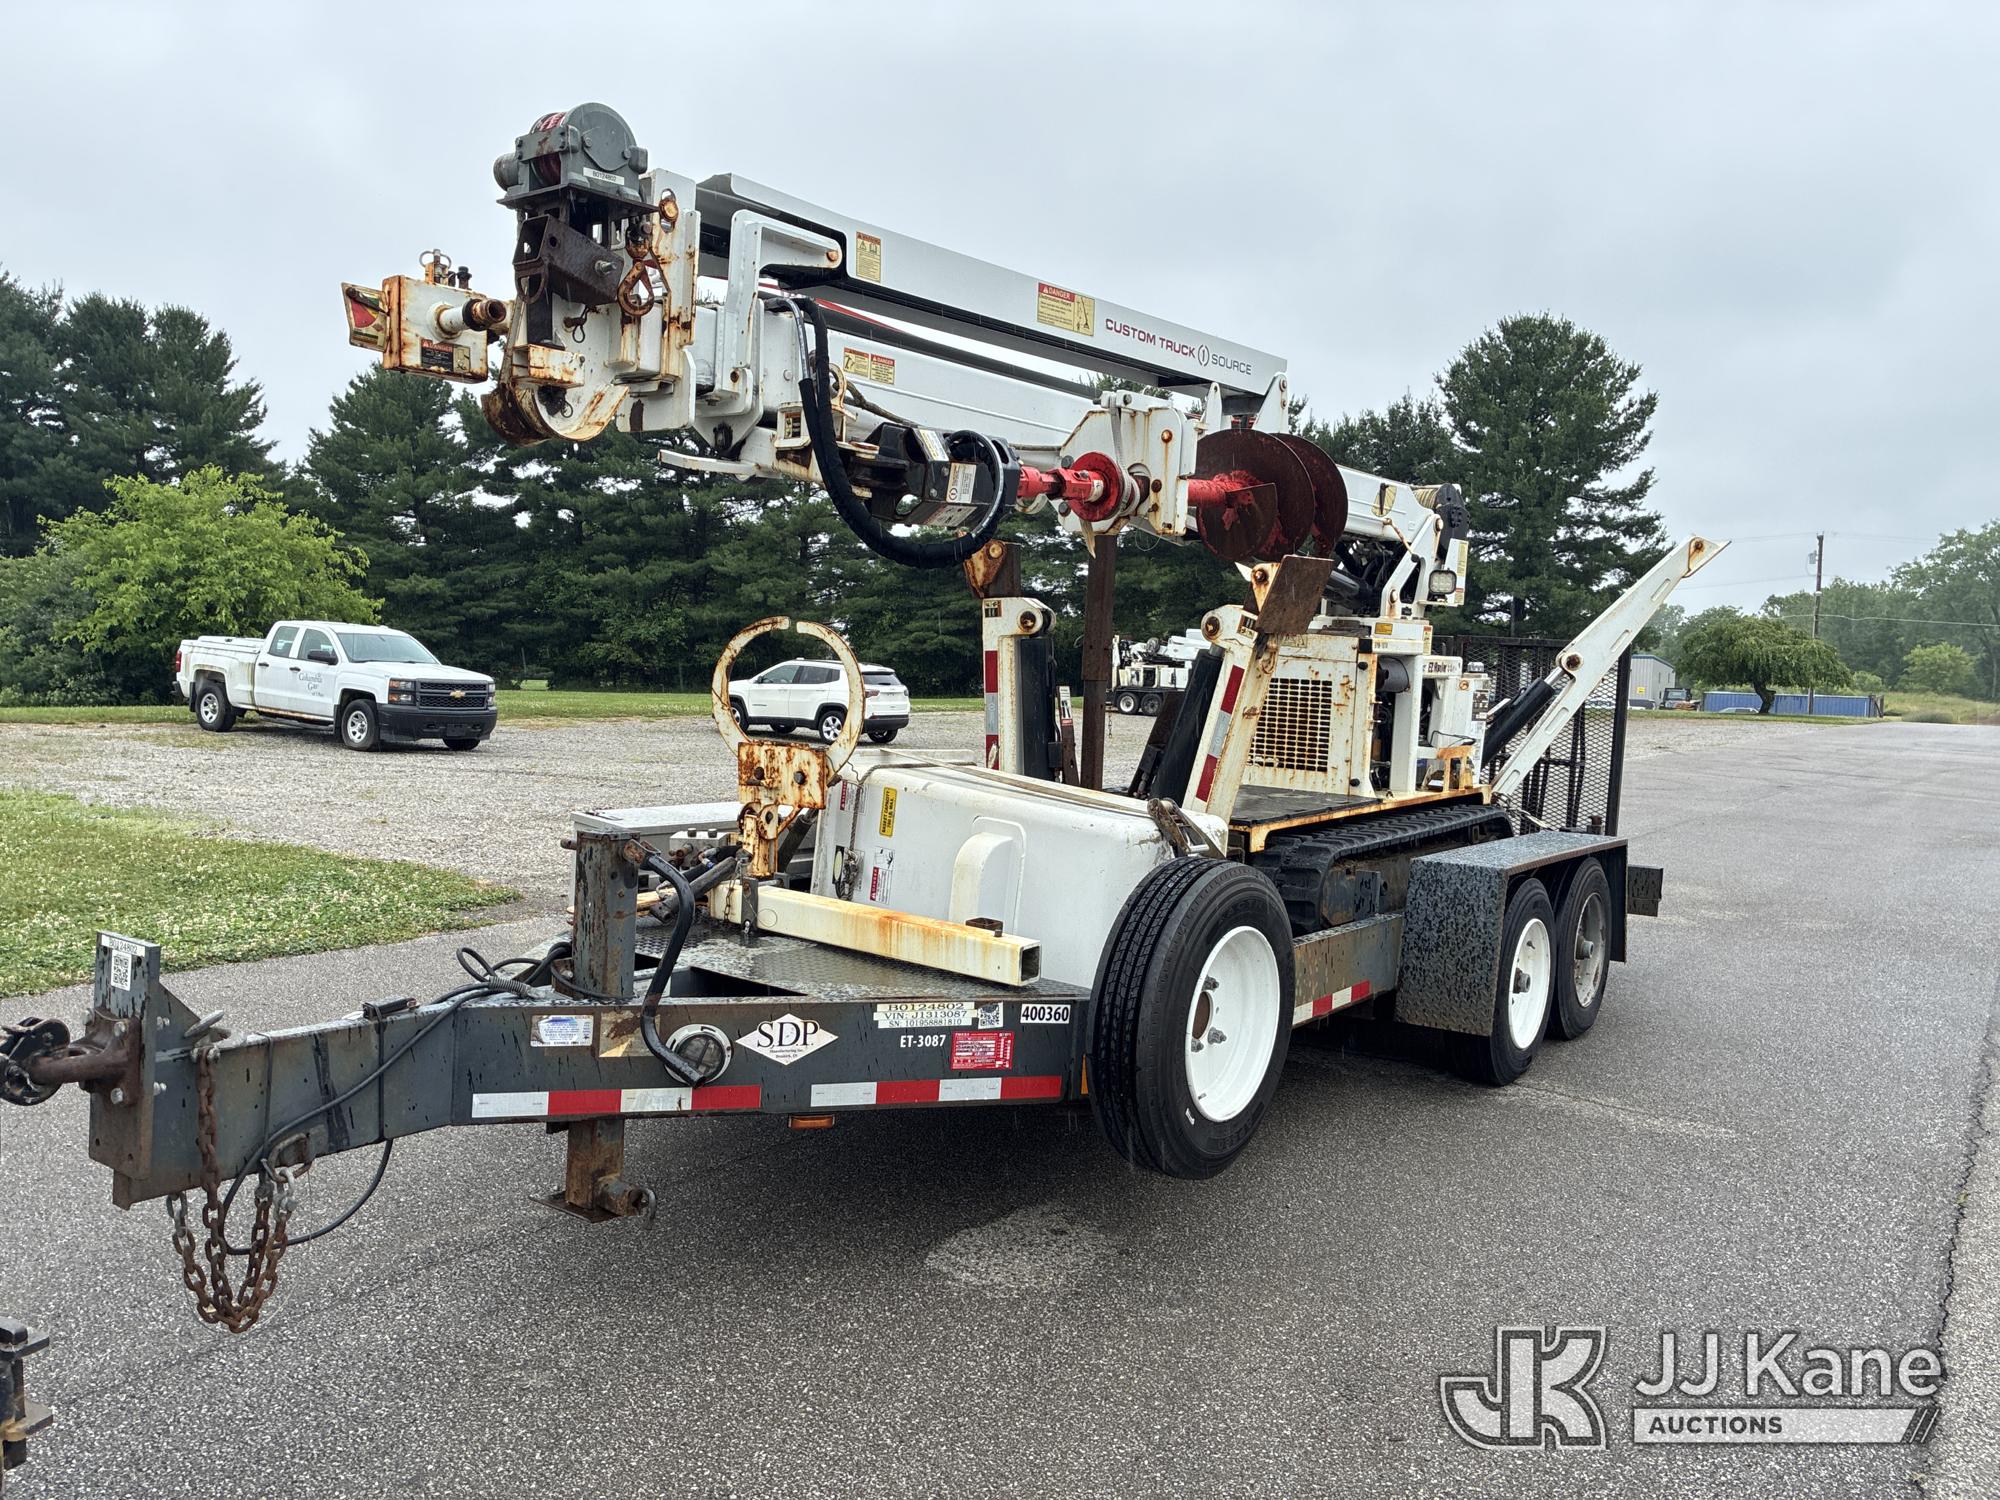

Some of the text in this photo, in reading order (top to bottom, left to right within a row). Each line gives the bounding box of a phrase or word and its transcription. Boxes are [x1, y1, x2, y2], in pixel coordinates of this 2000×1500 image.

[1048, 287, 1071, 300] DANGER
[1105, 318, 1156, 345] CUSTOM
[1159, 337, 1196, 358] TRUCK
[1211, 353, 1252, 375] SOURCE
[888, 1003, 964, 1011] B0124802
[1021, 1006, 1069, 1021] 400360
[912, 1010, 967, 1019] J1313087
[900, 1034, 947, 1048] ET-3087
